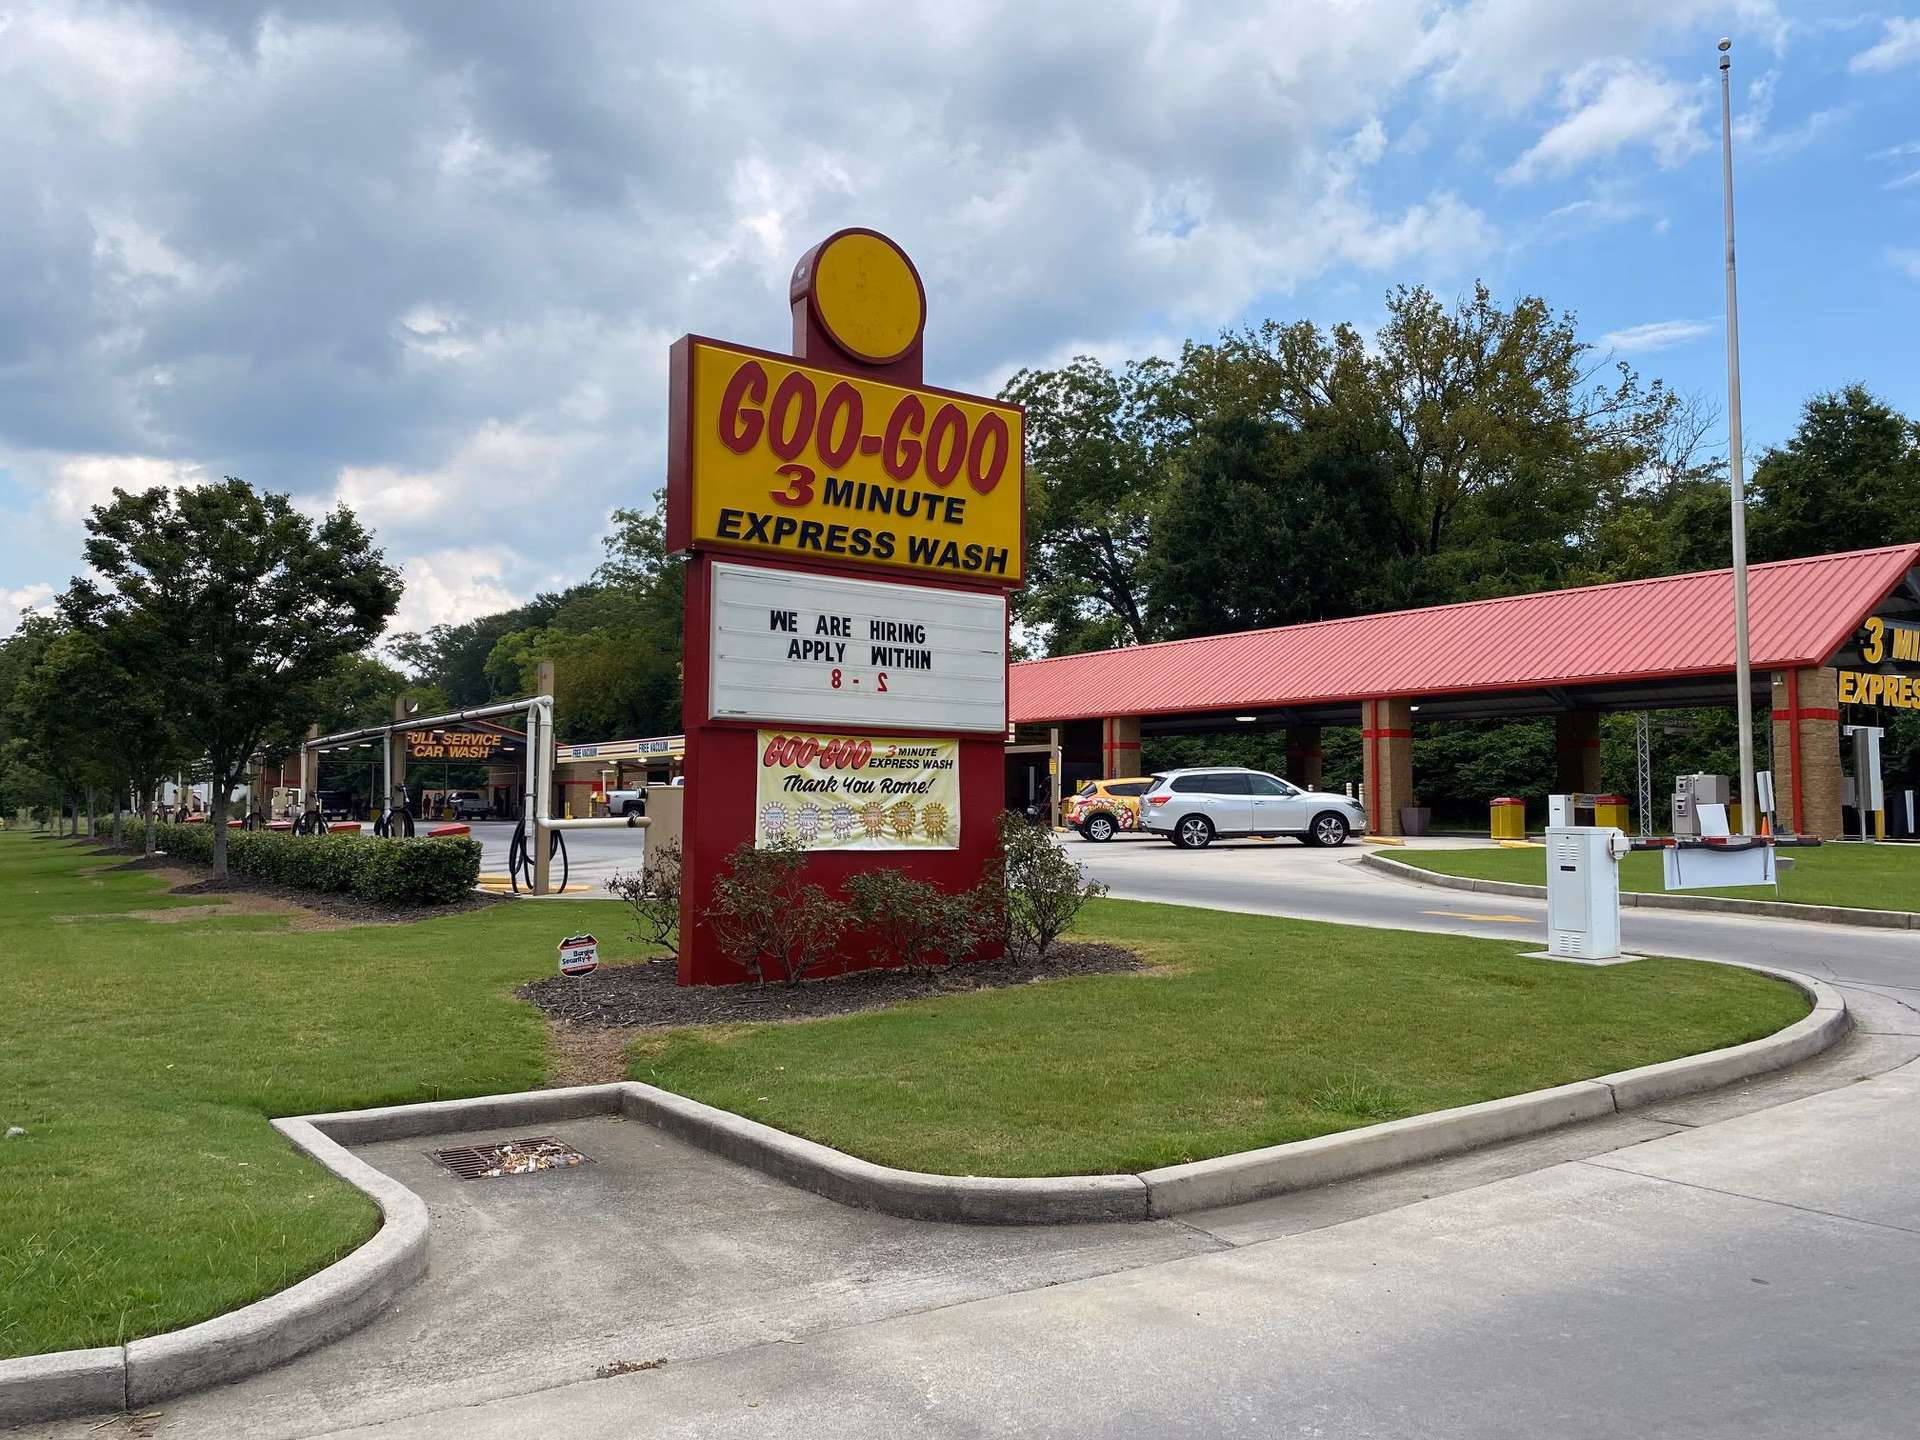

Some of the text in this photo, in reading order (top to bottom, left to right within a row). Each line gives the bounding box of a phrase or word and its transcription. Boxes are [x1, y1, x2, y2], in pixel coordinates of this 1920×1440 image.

[717, 360, 1009, 495] GOO-GOO
[769, 463, 967, 525] 3 MINUTE
[716, 508, 1009, 574] EXPRESS WASH
[770, 610, 926, 644] WE ARE HIRING
[1863, 616, 1920, 664] 3 MI
[787, 639, 931, 670] APPLY WITHIN
[831, 669, 842, 689] 8
[413, 746, 489, 758] CAR WASH
[442, 733, 502, 746] SERVICE
[638, 743, 649, 753] FREE
[763, 734, 873, 770] GOO-GOO
[885, 744, 938, 758] 3 MINUTE
[868, 758, 953, 770] EXPRESS WASH
[783, 774, 936, 794] Thank You Rome!
